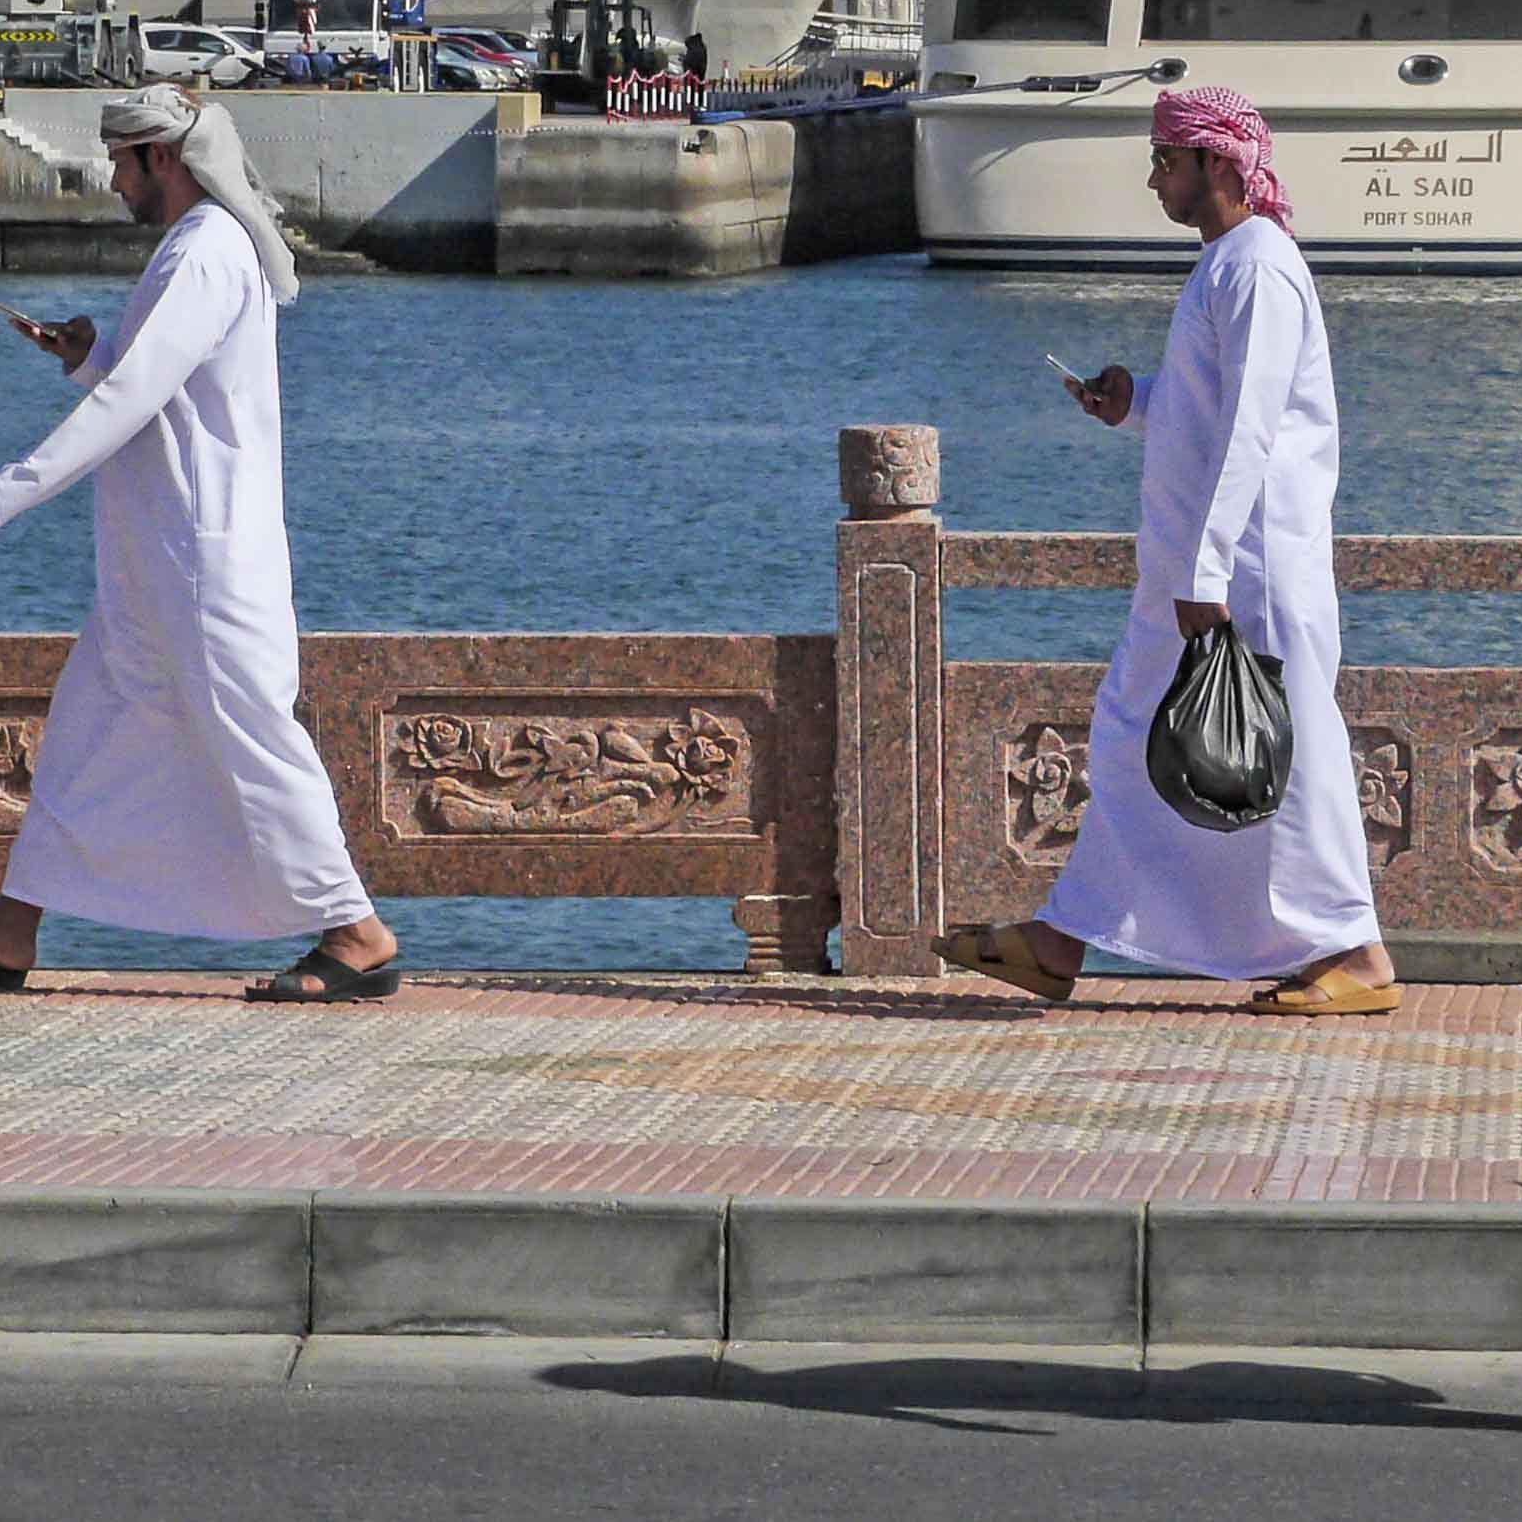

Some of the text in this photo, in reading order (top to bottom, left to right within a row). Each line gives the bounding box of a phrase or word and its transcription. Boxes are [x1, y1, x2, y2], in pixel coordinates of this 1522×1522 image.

[1340, 137, 1447, 173] سعيد
[1365, 177, 1473, 197] AL SAID
[1363, 211, 1473, 226] PORT SOHAR
